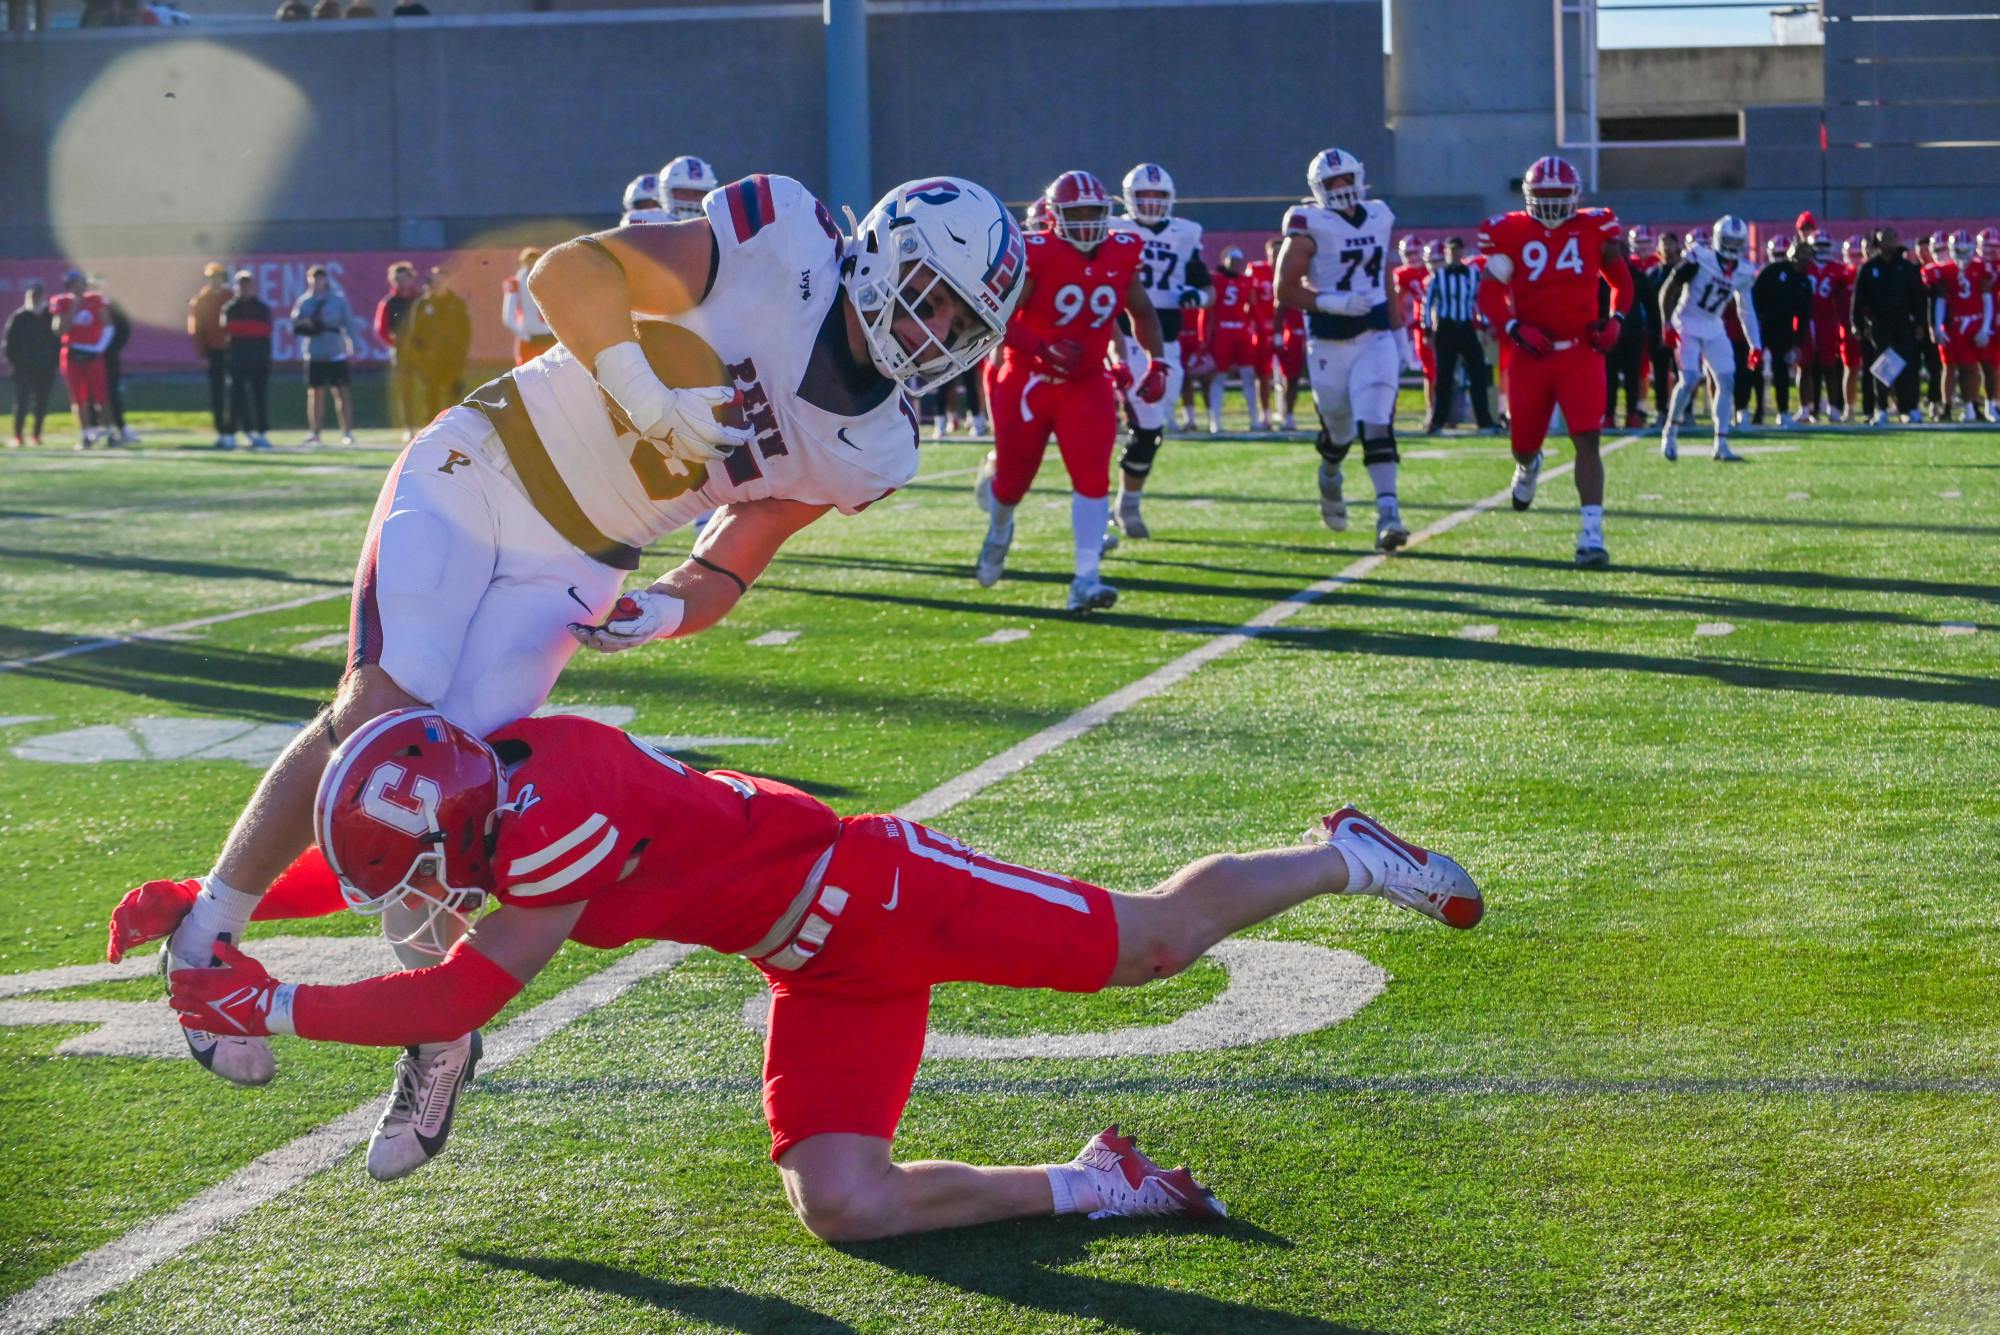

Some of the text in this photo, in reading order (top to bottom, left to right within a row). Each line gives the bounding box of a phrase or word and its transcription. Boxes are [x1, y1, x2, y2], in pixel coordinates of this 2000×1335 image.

[1336, 245, 1383, 292] 74
[1522, 237, 1585, 282] 94
[1054, 284, 1117, 328] 99
[1223, 285, 1239, 306] 5
[1697, 283, 1731, 313] 17
[726, 357, 789, 460] PENN
[438, 449, 471, 475] P
[360, 760, 443, 839] C
